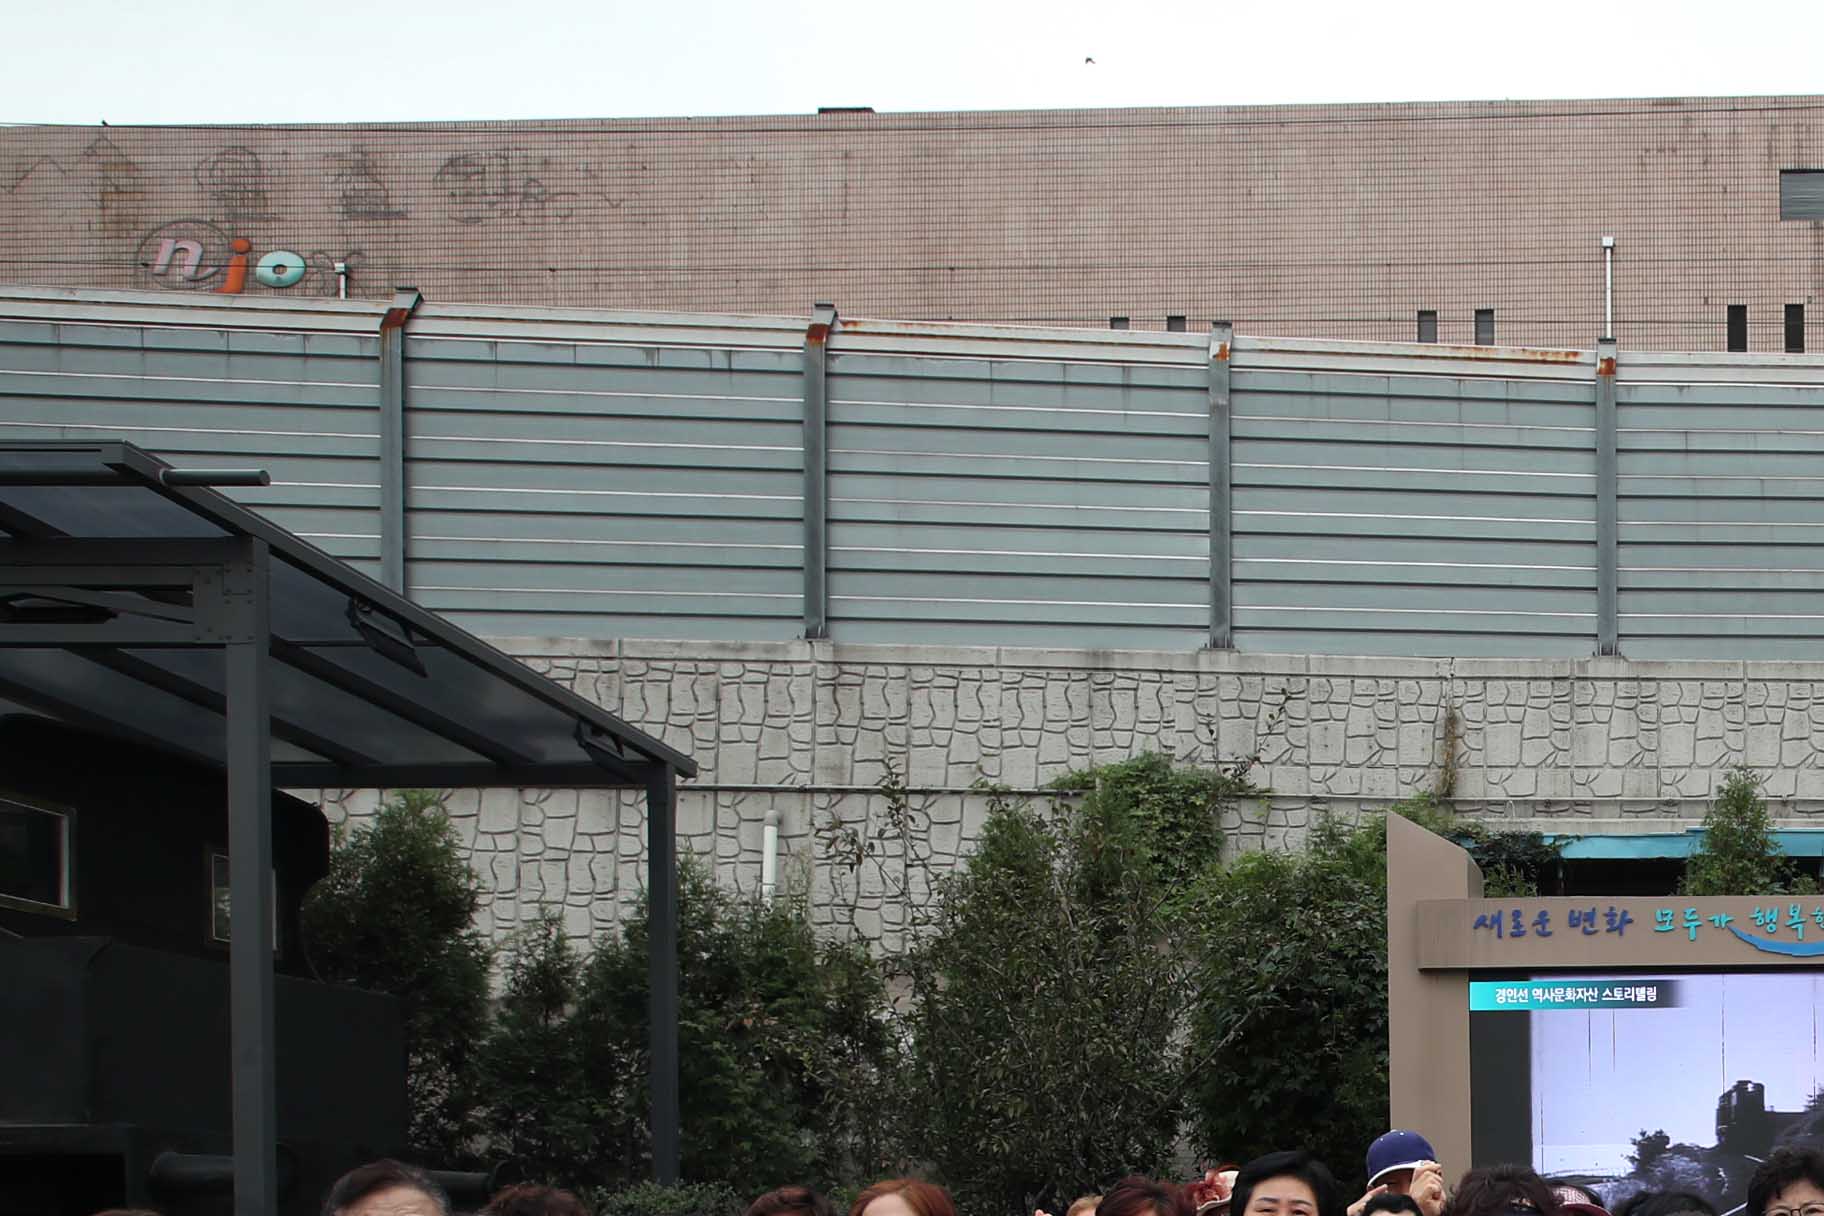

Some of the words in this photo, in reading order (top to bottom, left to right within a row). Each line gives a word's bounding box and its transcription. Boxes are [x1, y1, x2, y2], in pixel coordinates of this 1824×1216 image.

[1472, 911, 1553, 938] 새로운
[1567, 909, 1634, 938] 변화
[1495, 987, 1529, 1003] 경인선
[1532, 986, 1599, 1003] 역사문화자산
